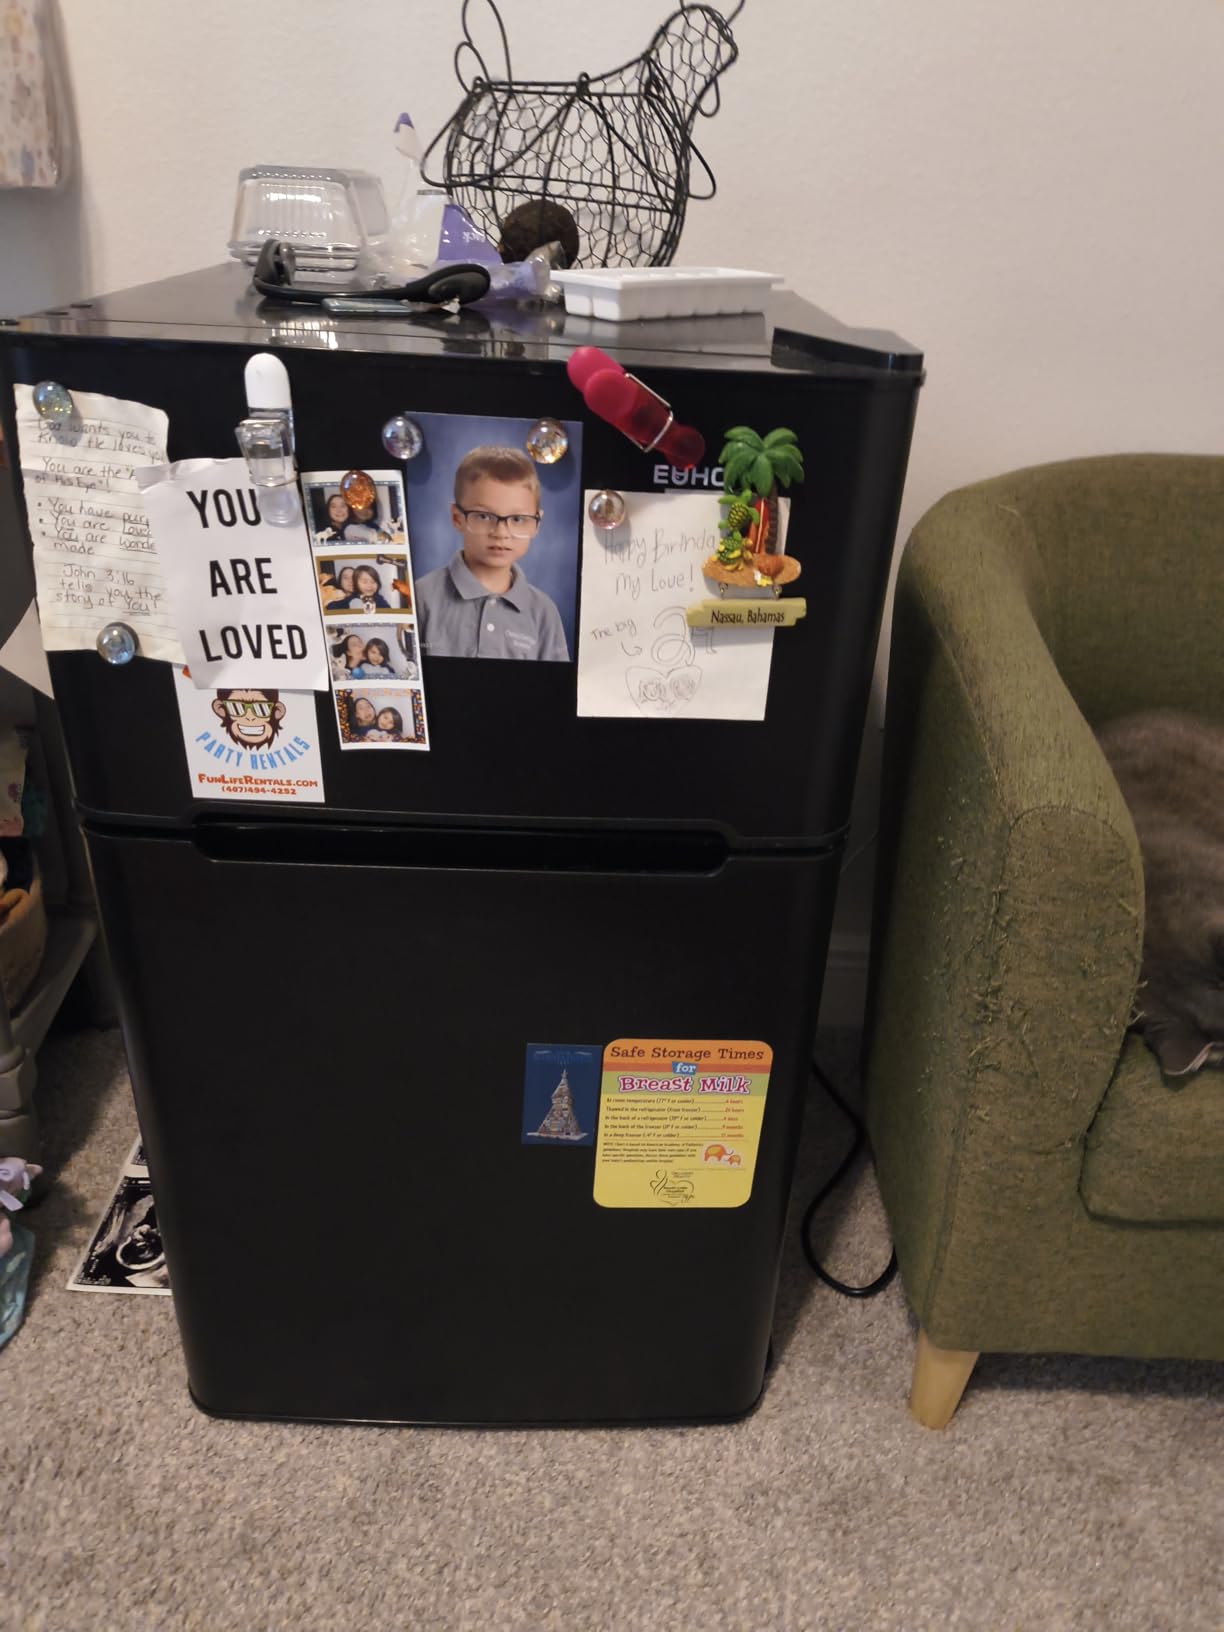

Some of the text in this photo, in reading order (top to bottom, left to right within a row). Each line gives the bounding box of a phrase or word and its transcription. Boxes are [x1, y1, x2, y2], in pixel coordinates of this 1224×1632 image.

[73, 422, 110, 435] wants
[119, 430, 139, 441] you
[114, 440, 145, 455] loves
[42, 457, 66, 473] You
[74, 466, 96, 476] are
[100, 465, 120, 478] the
[35, 474, 46, 484] of
[48, 497, 72, 514] You
[80, 500, 113, 518] have
[187, 488, 263, 529] YOU
[50, 511, 75, 527] You
[83, 520, 110, 531] are
[57, 530, 79, 543] You
[85, 532, 107, 544] are
[54, 542, 95, 555] made
[604, 529, 647, 568] Happy
[63, 563, 135, 585] John 3:16
[209, 557, 278, 597] ARE
[615, 564, 695, 600] My Love!
[56, 590, 94, 610] story
[99, 596, 114, 607] of
[60, 578, 162, 602] tells you the
[711, 609, 785, 623] Nassau, Bahamas
[200, 624, 307, 662] LOVED
[591, 627, 612, 640] The
[195, 731, 311, 770] PARTY RENTALS
[610, 1046, 764, 1061] Safe Storage Times
[676, 1063, 697, 1074] for
[619, 1075, 751, 1094] Breast Milk
